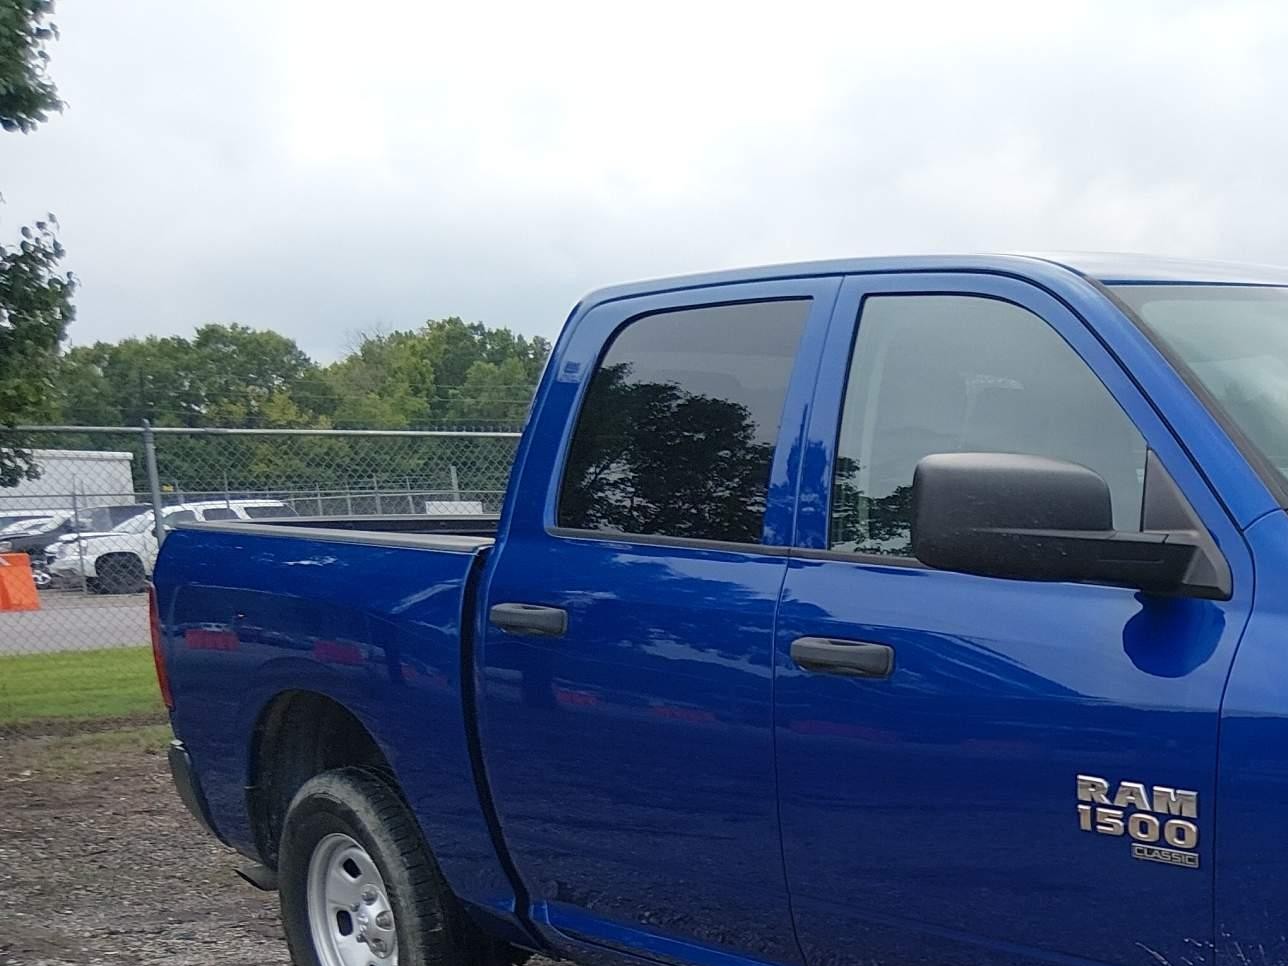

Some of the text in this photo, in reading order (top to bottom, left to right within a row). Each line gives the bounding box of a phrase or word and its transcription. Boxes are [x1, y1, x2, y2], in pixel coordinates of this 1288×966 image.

[1077, 774, 1198, 818] RAM
[1077, 804, 1198, 849] 1500
[1134, 846, 1196, 866] CLASSIC
